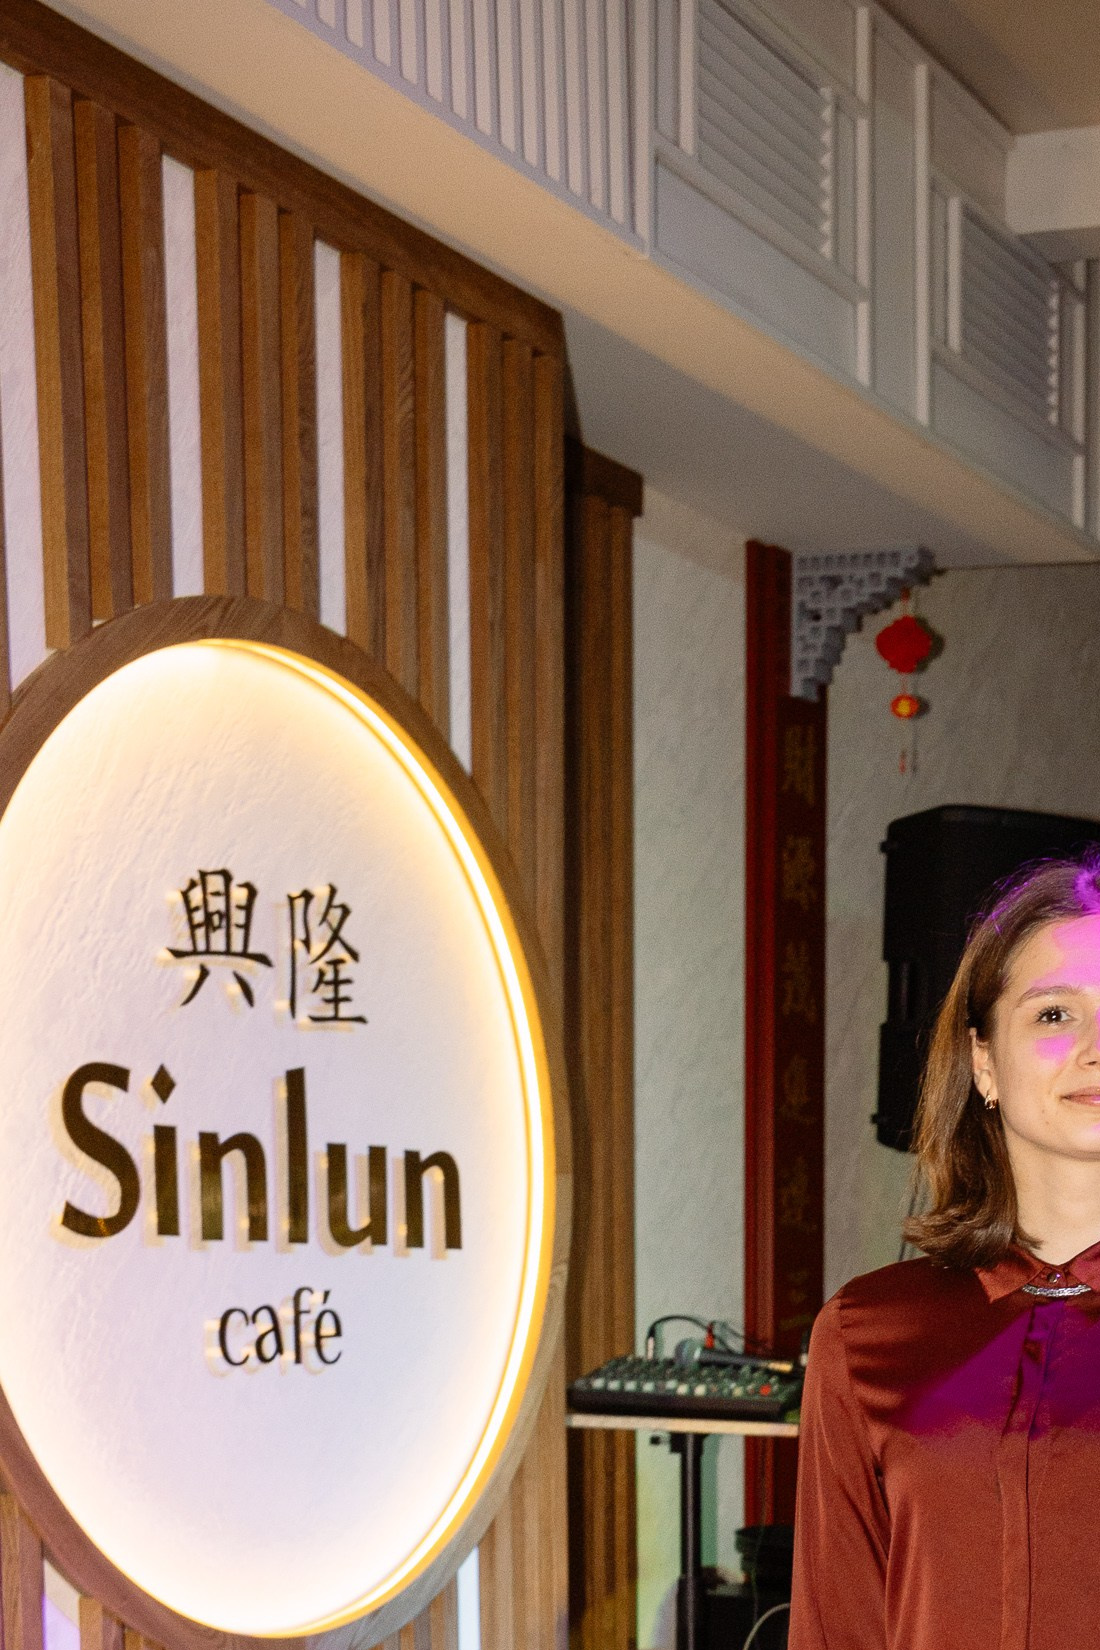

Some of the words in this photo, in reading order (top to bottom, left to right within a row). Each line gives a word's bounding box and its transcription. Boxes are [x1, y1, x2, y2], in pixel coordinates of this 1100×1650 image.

[166, 868, 369, 1024] 興隆
[60, 1061, 463, 1250] Sinlun
[217, 1286, 343, 1366] café
